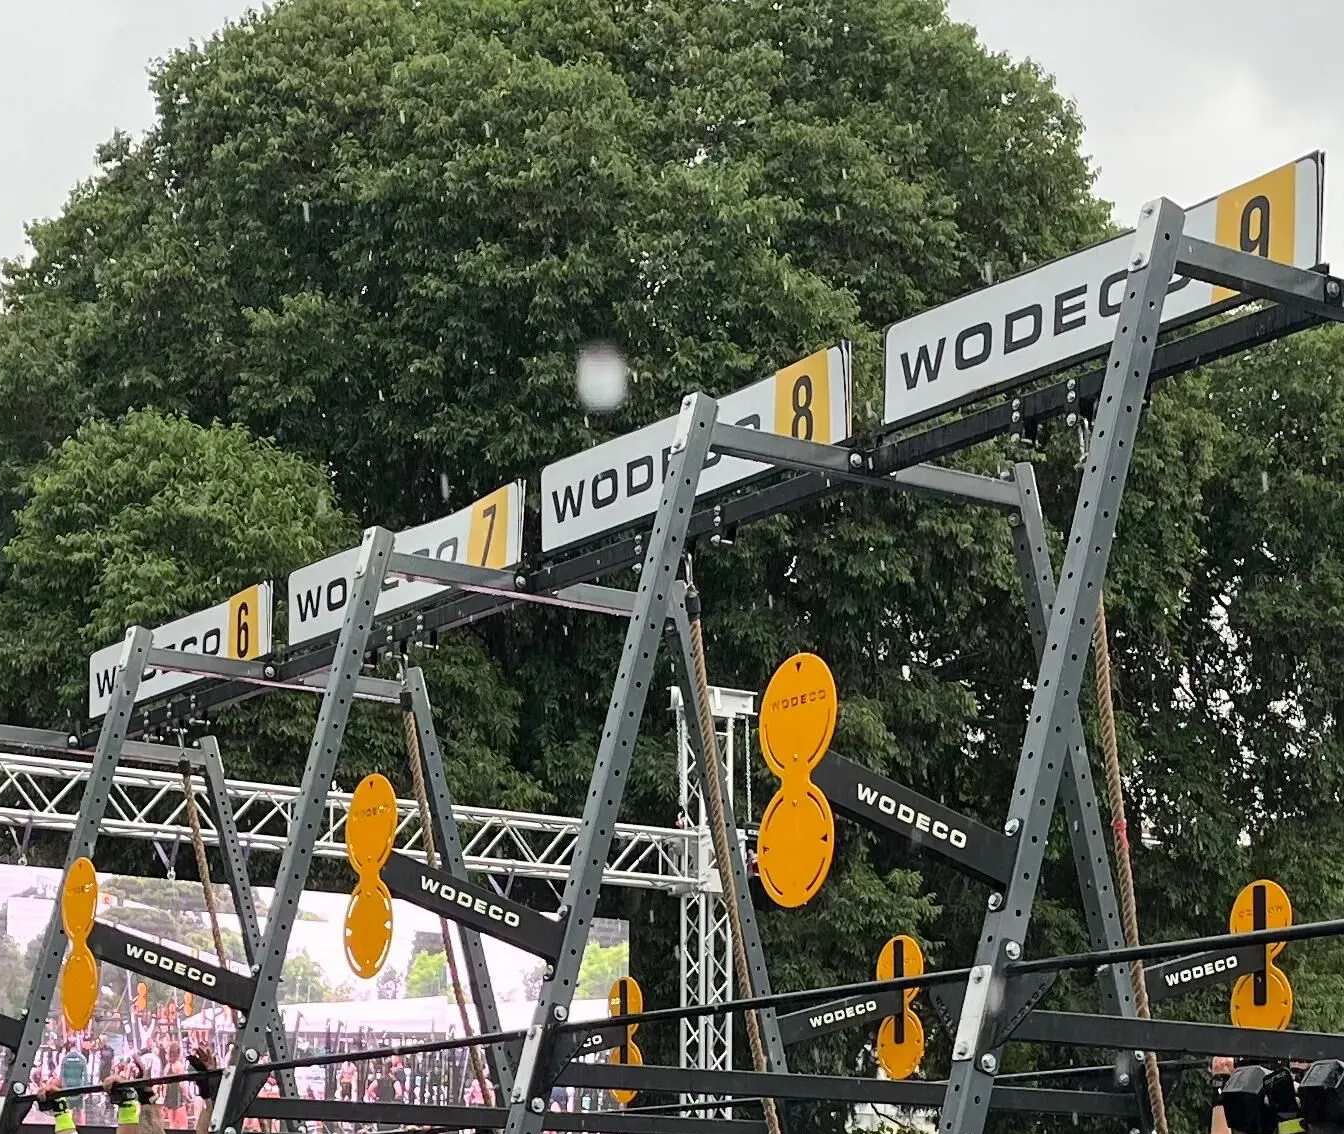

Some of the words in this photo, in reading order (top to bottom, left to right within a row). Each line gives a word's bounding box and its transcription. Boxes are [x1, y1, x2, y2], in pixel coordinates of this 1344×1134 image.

[1239, 195, 1271, 257] 9
[791, 374, 814, 441] 8
[482, 503, 497, 567] 7
[237, 601, 249, 659] 6
[856, 783, 968, 849] WODECO
[421, 875, 520, 928] WODECO
[125, 943, 218, 988] WODECO
[1164, 955, 1238, 987] WODECO
[808, 1000, 878, 1029] WODECO
